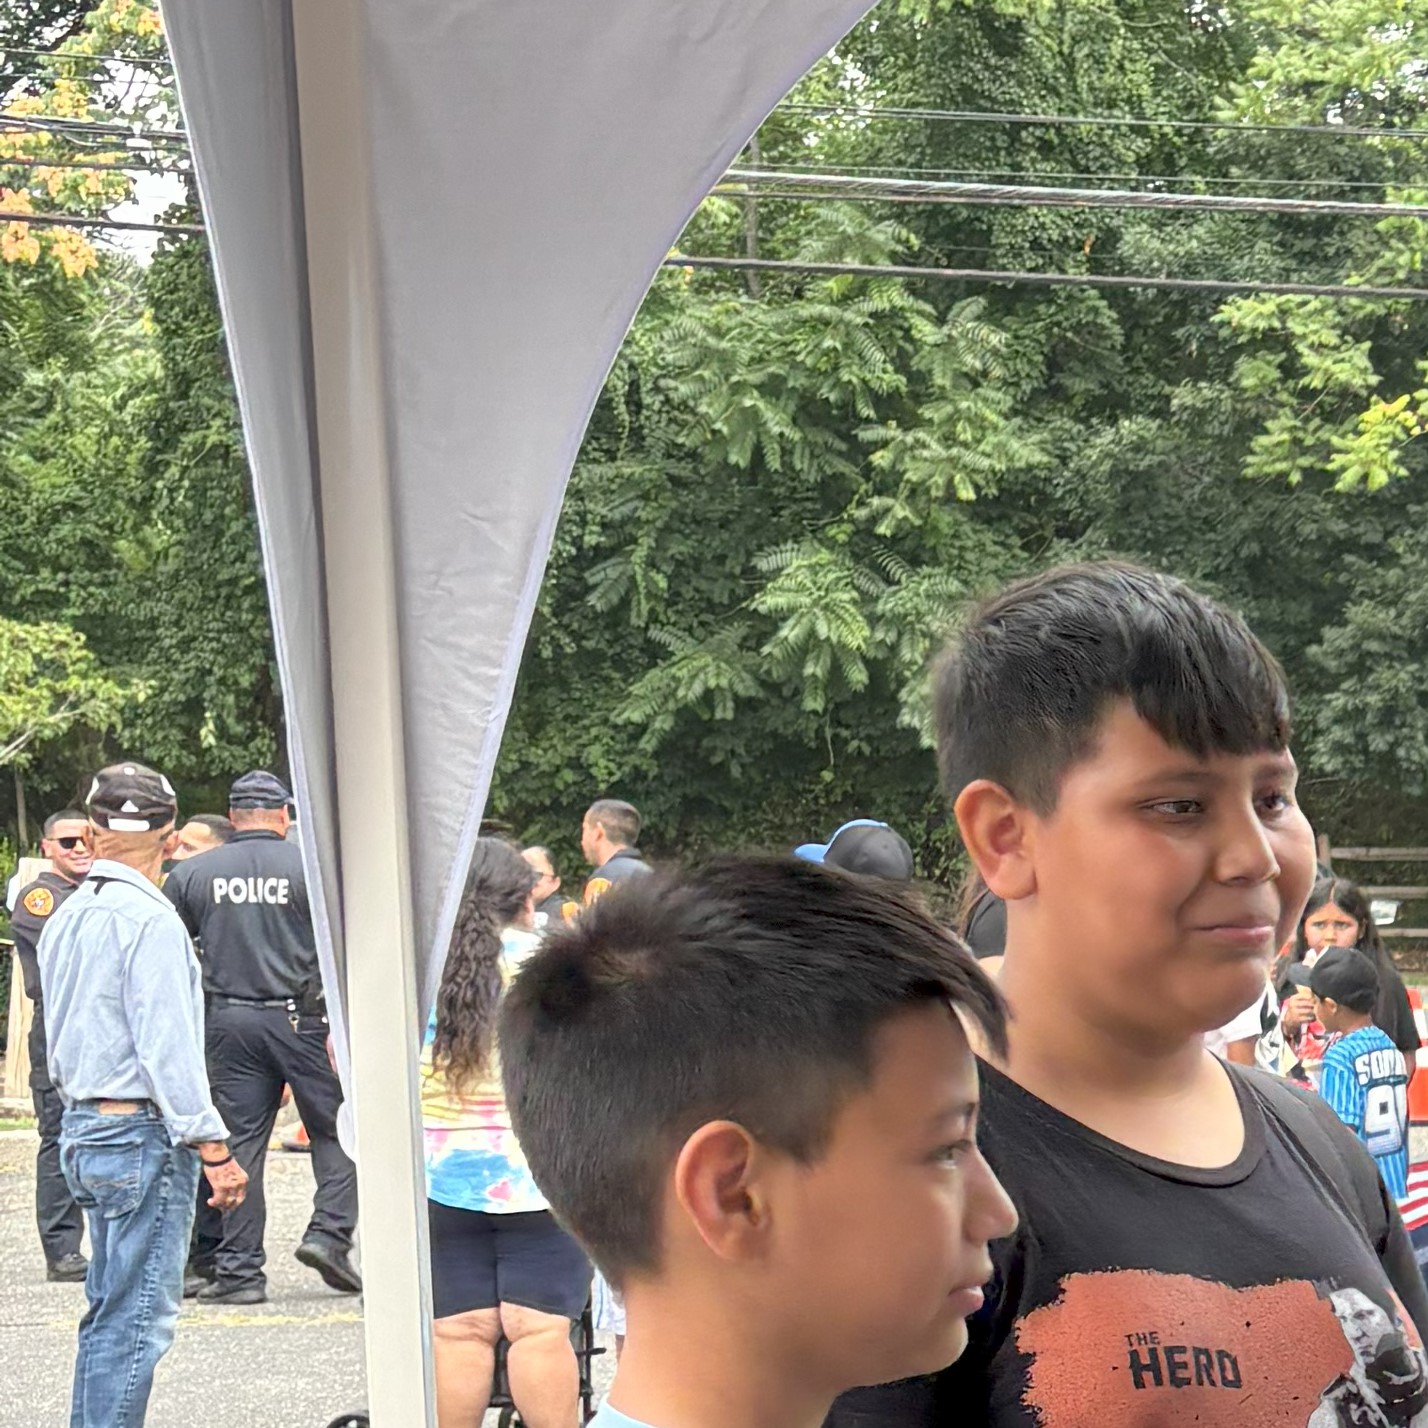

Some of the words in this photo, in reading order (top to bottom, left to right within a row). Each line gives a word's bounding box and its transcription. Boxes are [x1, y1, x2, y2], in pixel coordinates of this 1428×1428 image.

[213, 877, 289, 904] POLICE
[1124, 1331, 1160, 1347] THE
[1129, 1345, 1242, 1389] HERO
